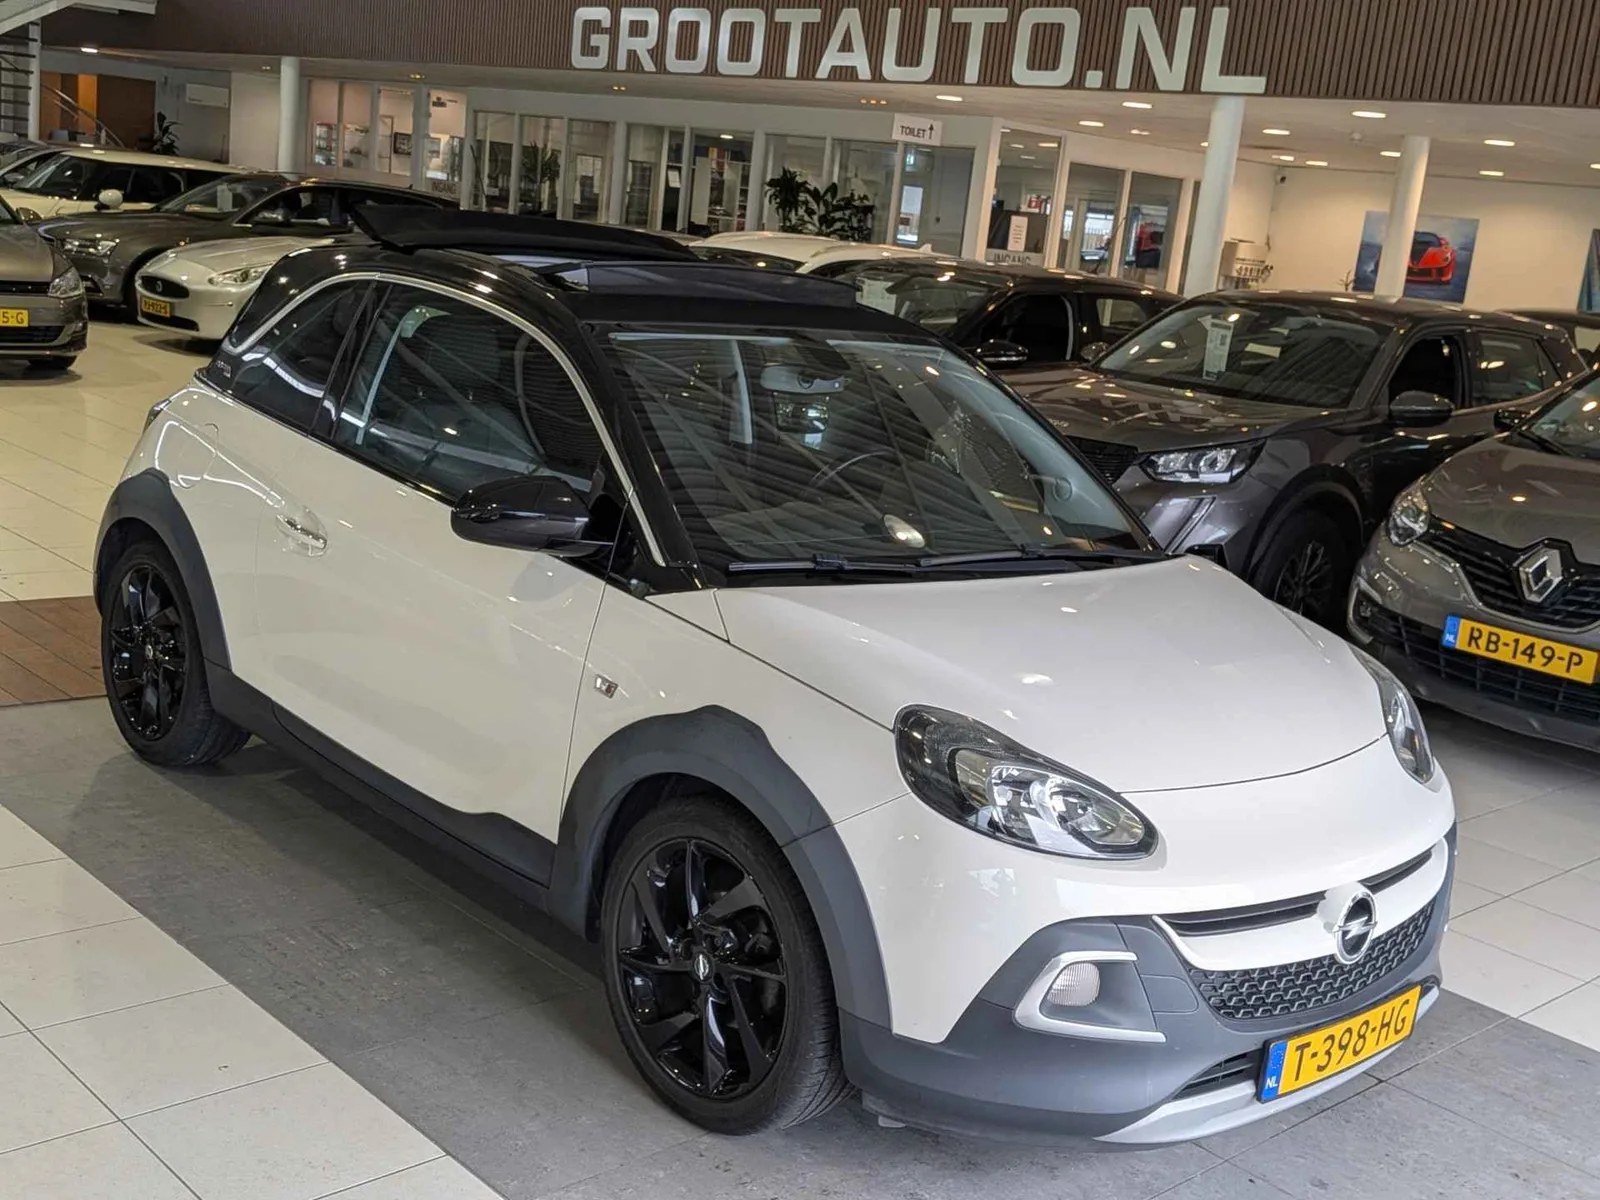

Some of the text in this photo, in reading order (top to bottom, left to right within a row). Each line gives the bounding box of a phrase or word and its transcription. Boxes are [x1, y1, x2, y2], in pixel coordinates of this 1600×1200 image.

[571, 7, 1267, 94] GROOTAUTO.NL
[900, 125, 926, 138] TOILET
[1467, 626, 1583, 673] RB-149-P
[1294, 998, 1410, 1082] T-398-HG
[1265, 1076, 1278, 1090] NL
